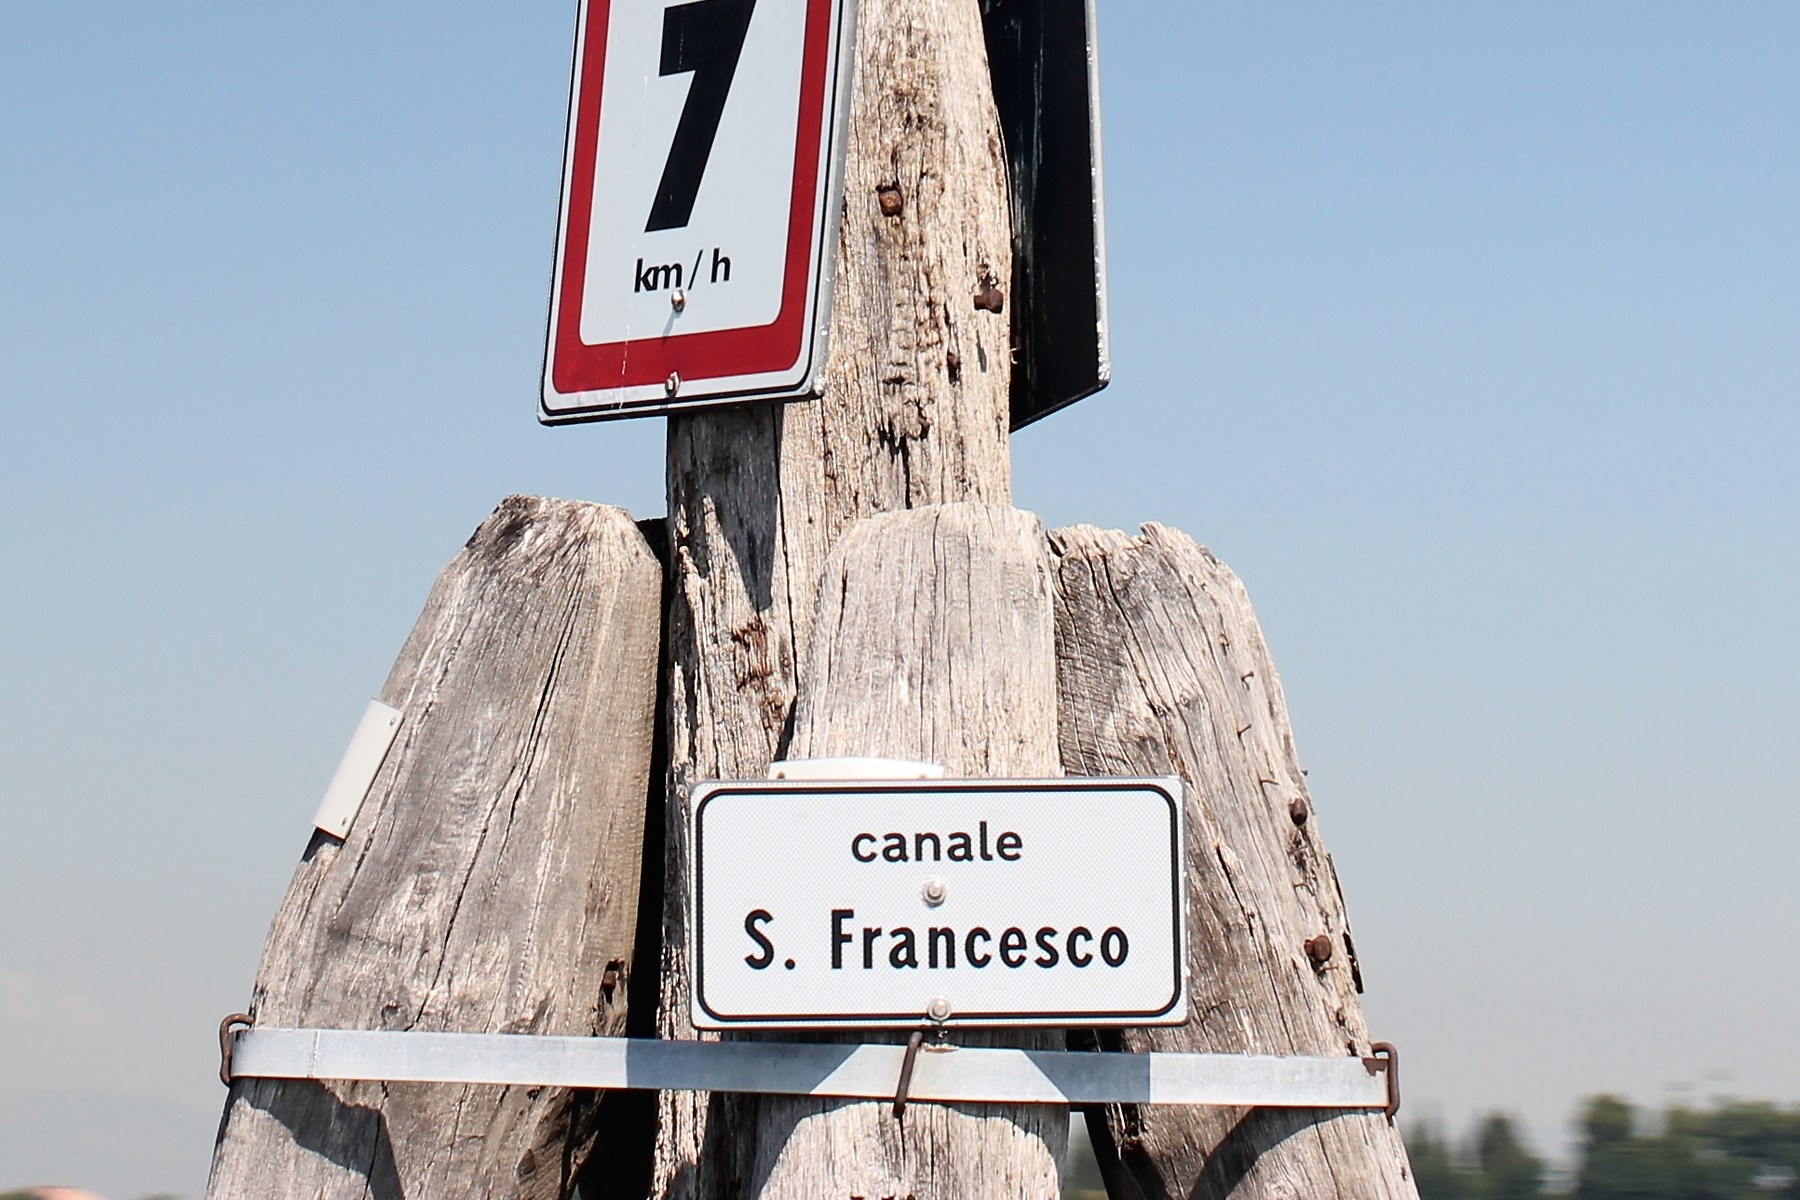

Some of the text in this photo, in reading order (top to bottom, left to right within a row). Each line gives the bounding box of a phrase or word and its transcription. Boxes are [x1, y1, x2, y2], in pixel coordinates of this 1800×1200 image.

[634, 247, 731, 293] km/h
[851, 820, 1023, 863] canale
[744, 908, 1129, 971] S. Francesco
